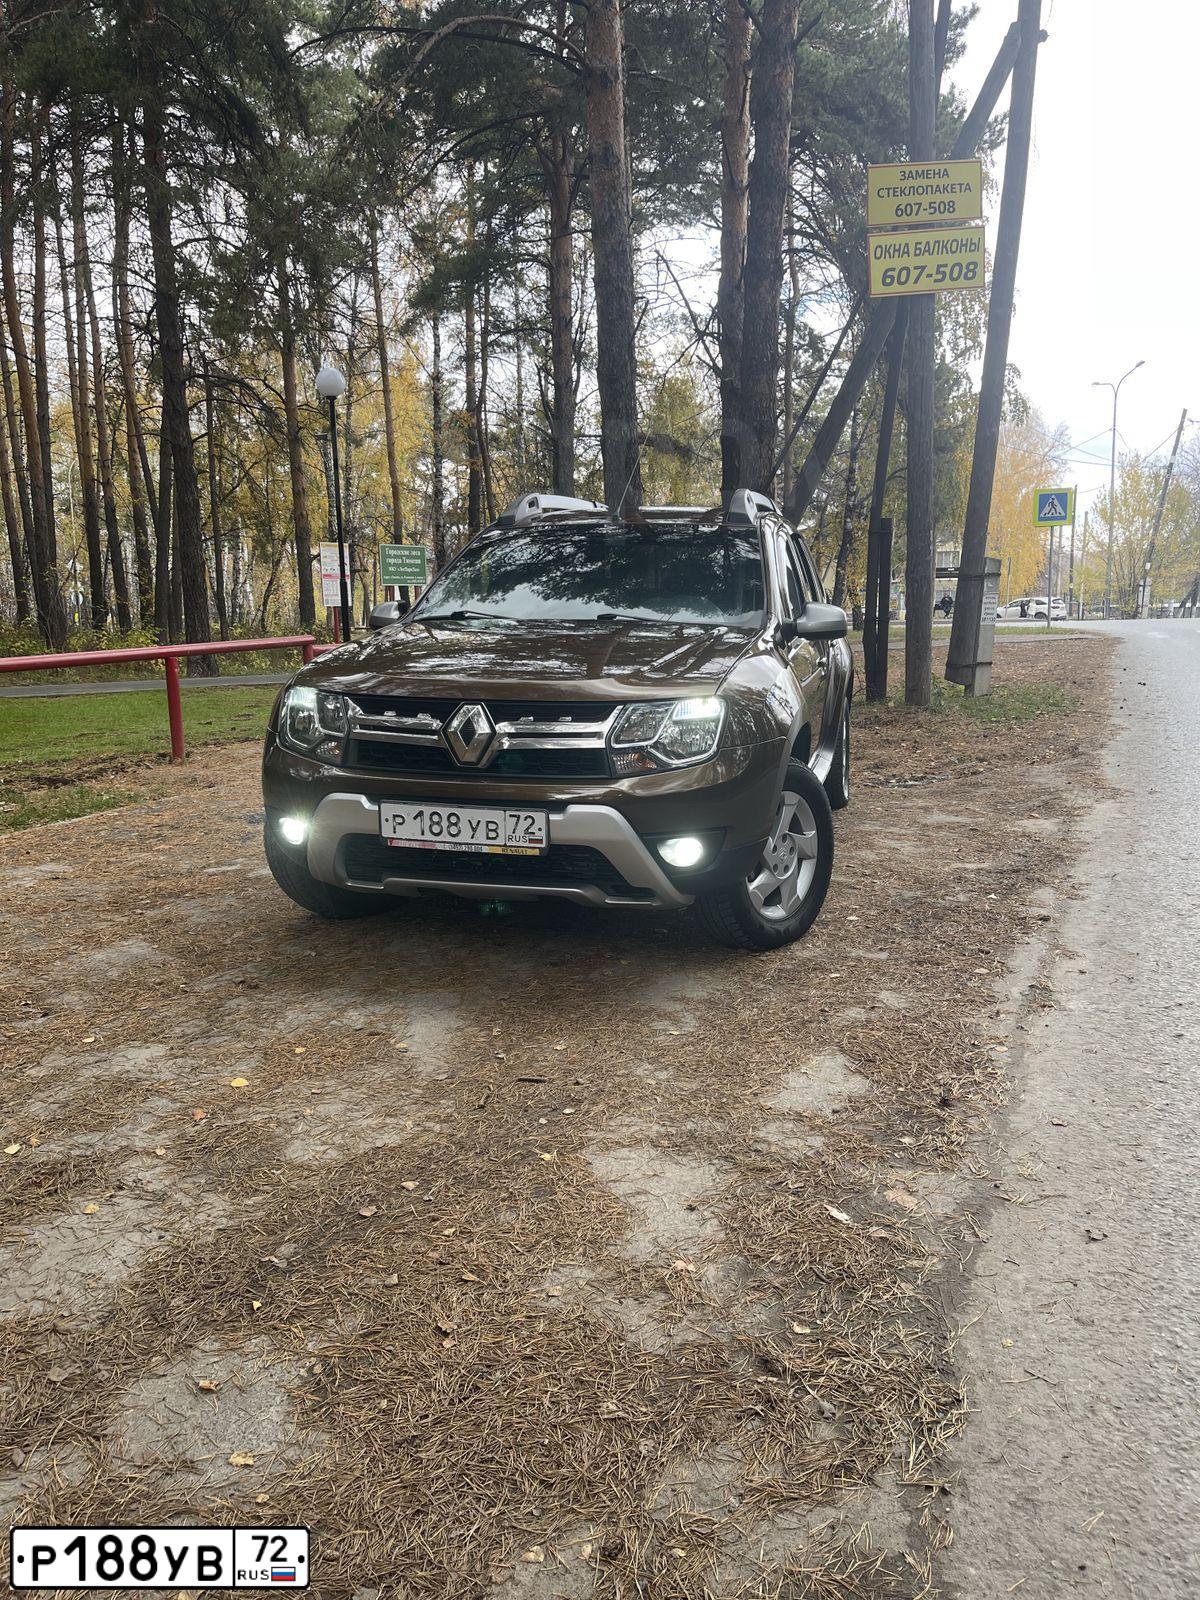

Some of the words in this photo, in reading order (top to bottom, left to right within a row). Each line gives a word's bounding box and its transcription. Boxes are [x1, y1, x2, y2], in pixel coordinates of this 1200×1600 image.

[899, 168, 950, 181] ЗАМЕНА
[876, 182, 972, 199] СТЕКЛОПАКЕТА
[894, 200, 956, 218] 607-508
[873, 242, 911, 260] ОКНА
[913, 236, 981, 257] БАЛКОНЫ
[881, 261, 979, 287] 607-508
[509, 814, 536, 835] 72
[507, 834, 528, 844] RUS
[501, 847, 528, 856] RENAULT
